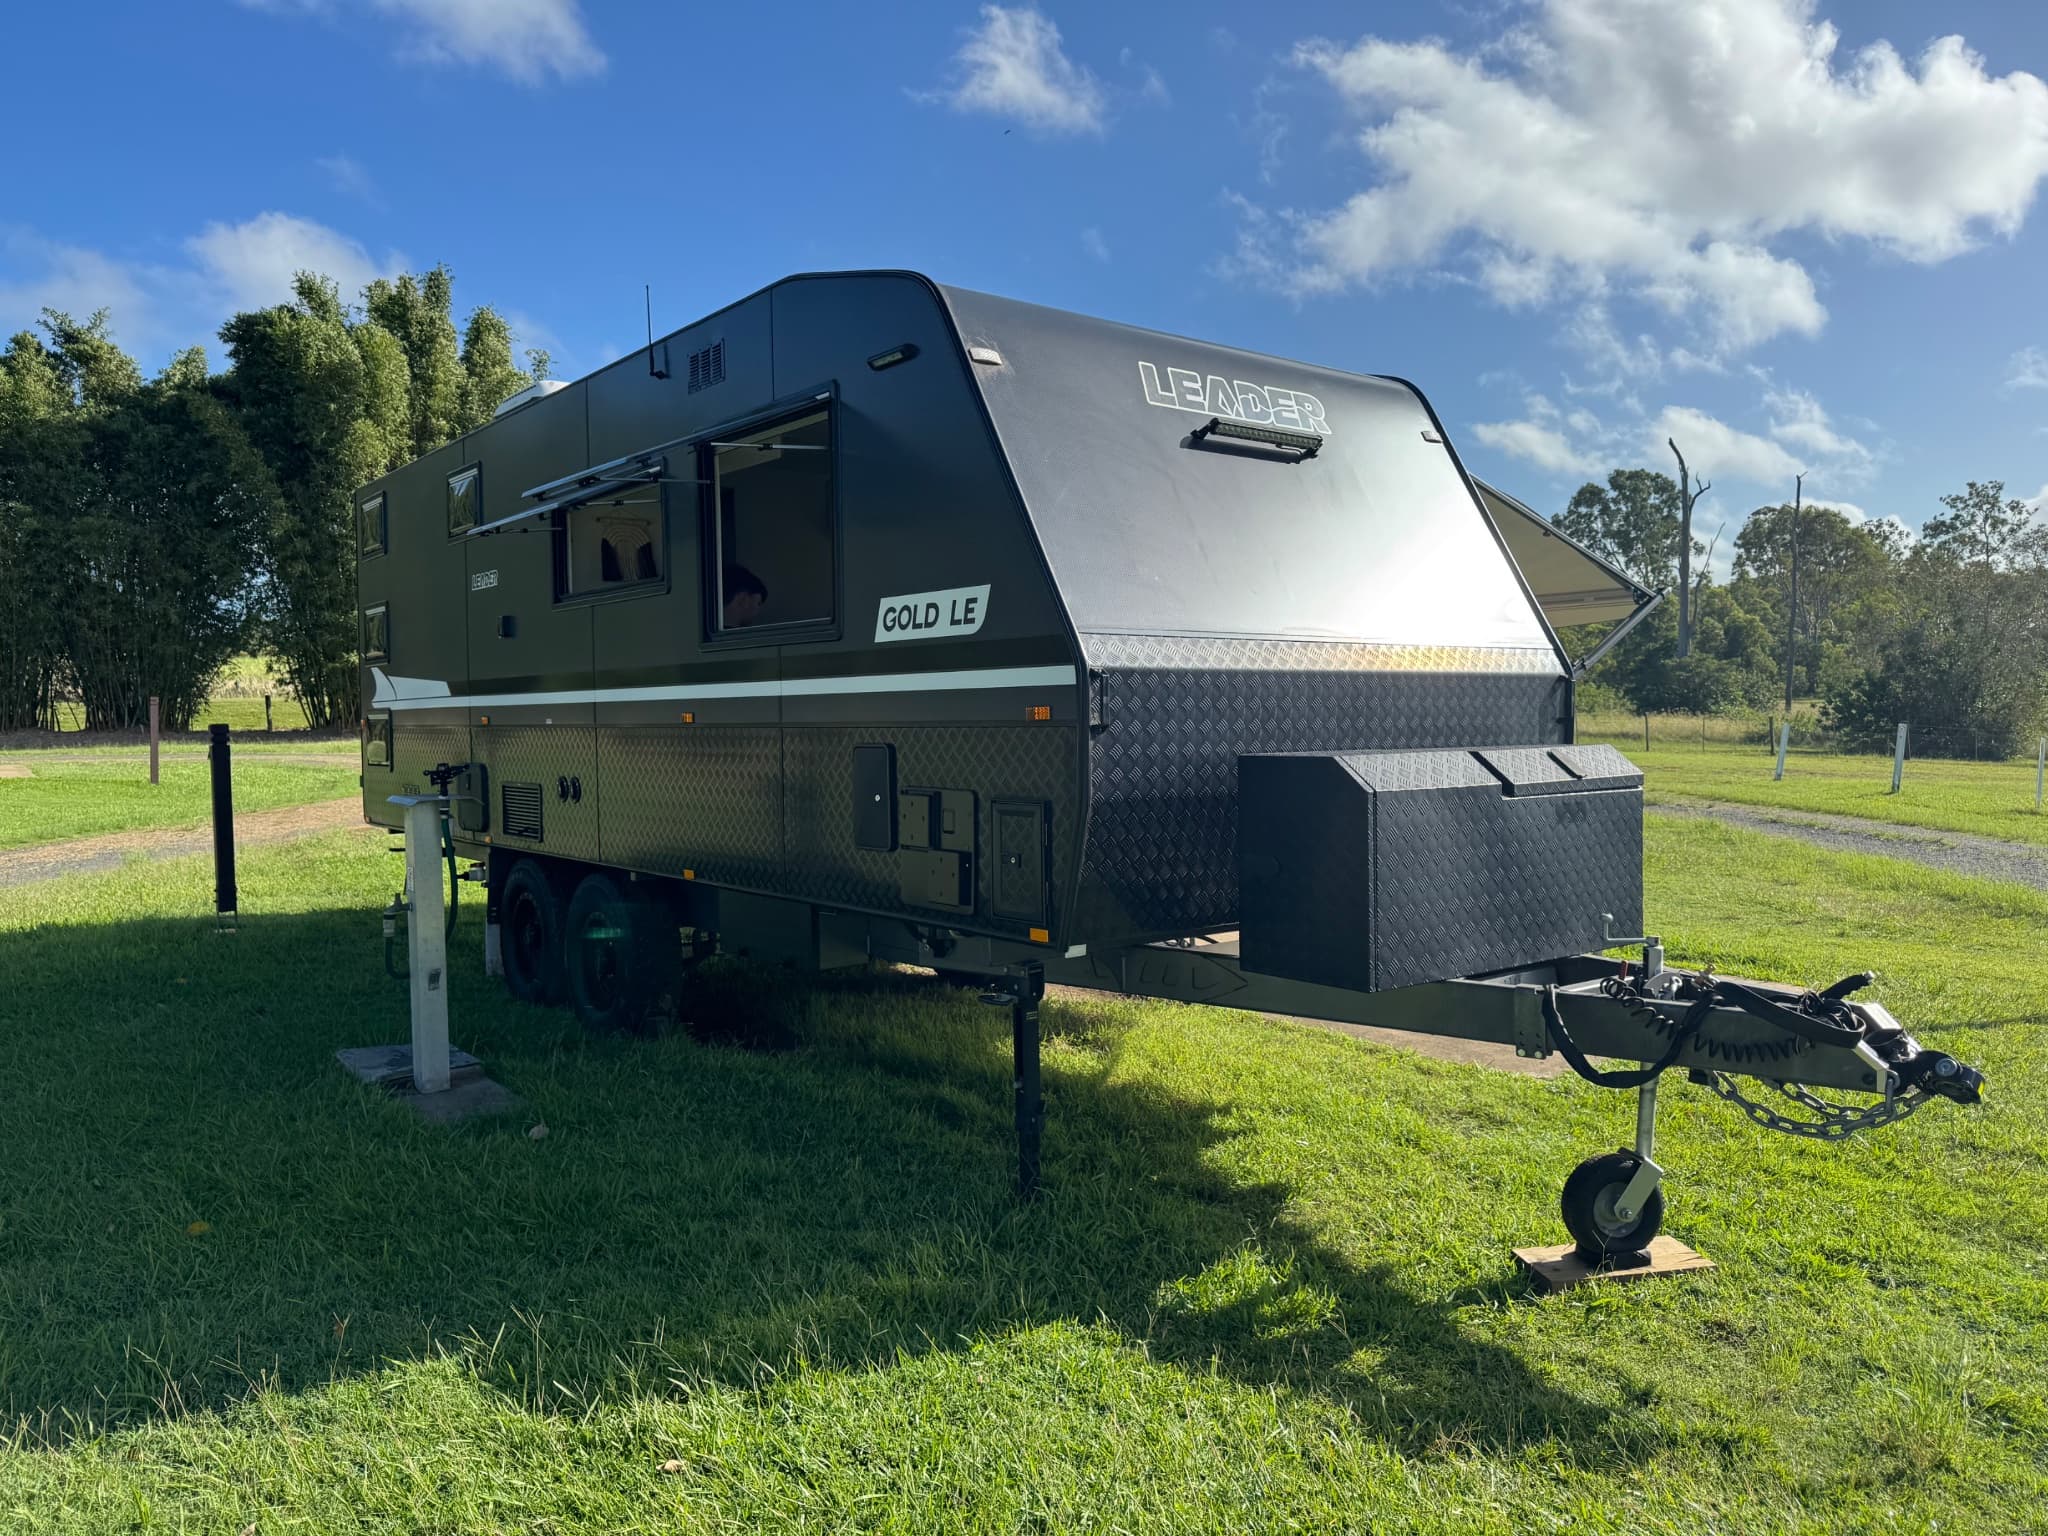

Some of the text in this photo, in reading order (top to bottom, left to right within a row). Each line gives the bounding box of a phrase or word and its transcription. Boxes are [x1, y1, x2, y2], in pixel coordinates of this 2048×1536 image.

[1138, 361, 1332, 434] LEADER
[882, 597, 978, 632] GOLD LE
